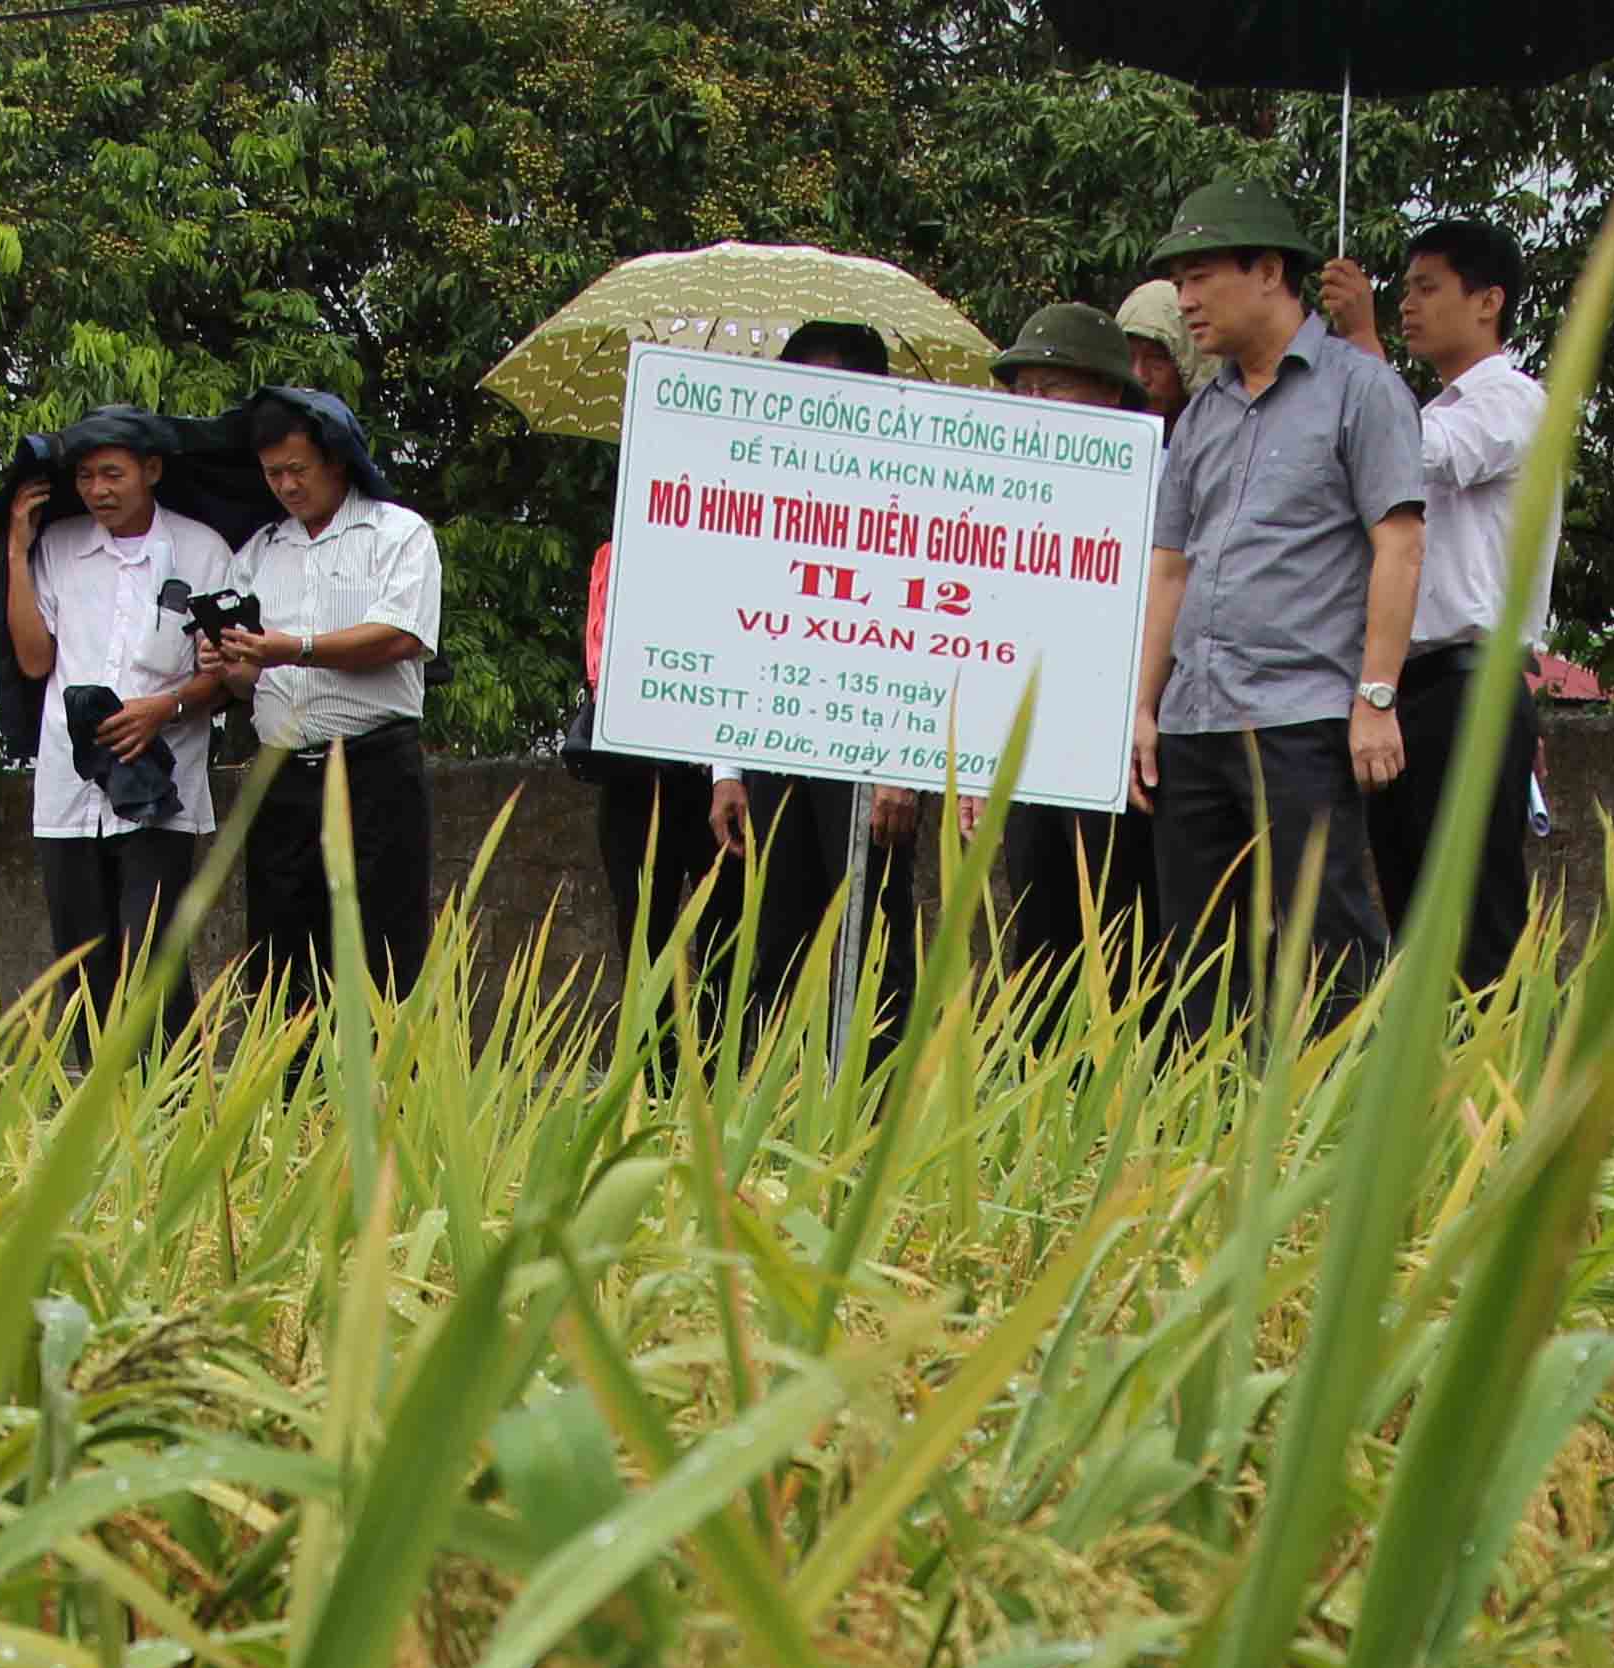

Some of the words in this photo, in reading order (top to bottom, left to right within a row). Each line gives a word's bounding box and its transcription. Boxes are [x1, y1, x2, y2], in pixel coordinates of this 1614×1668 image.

[657, 373, 722, 413] CÔNG
[729, 387, 758, 417] TY
[762, 393, 794, 422] CP
[799, 390, 871, 433] GIỐNG
[877, 404, 923, 440] CÂY
[1012, 419, 1049, 458] HẢI
[1055, 432, 1134, 469] DƯƠNG
[770, 441, 806, 470] TÀI
[814, 448, 860, 477] LÚA
[869, 460, 936, 488] KHCN
[943, 466, 995, 496] NĂM
[1002, 478, 1054, 504] 2016
[648, 473, 691, 528] MÔ
[698, 478, 764, 537] HÌNH
[773, 490, 850, 549] TRÌNH
[856, 493, 919, 557] DIỄN
[926, 506, 1007, 569] GIỐNG
[1014, 522, 1062, 576] LÚA
[1070, 527, 1122, 584] MỚI
[789, 559, 872, 606] TL
[898, 576, 973, 616] 12
[737, 608, 791, 641] VỤ
[803, 616, 916, 652] XUÂN
[929, 633, 1017, 664] 2016
[644, 647, 714, 674] TGST
[837, 672, 879, 695] 135
[887, 680, 947, 707] ngày
[772, 697, 801, 717] 80
[825, 702, 854, 723] 95
[862, 708, 884, 734] tạ
[907, 711, 937, 734] ha
[715, 723, 757, 752] Đại
[764, 729, 819, 758] Đức,
[828, 740, 890, 767] ngày
